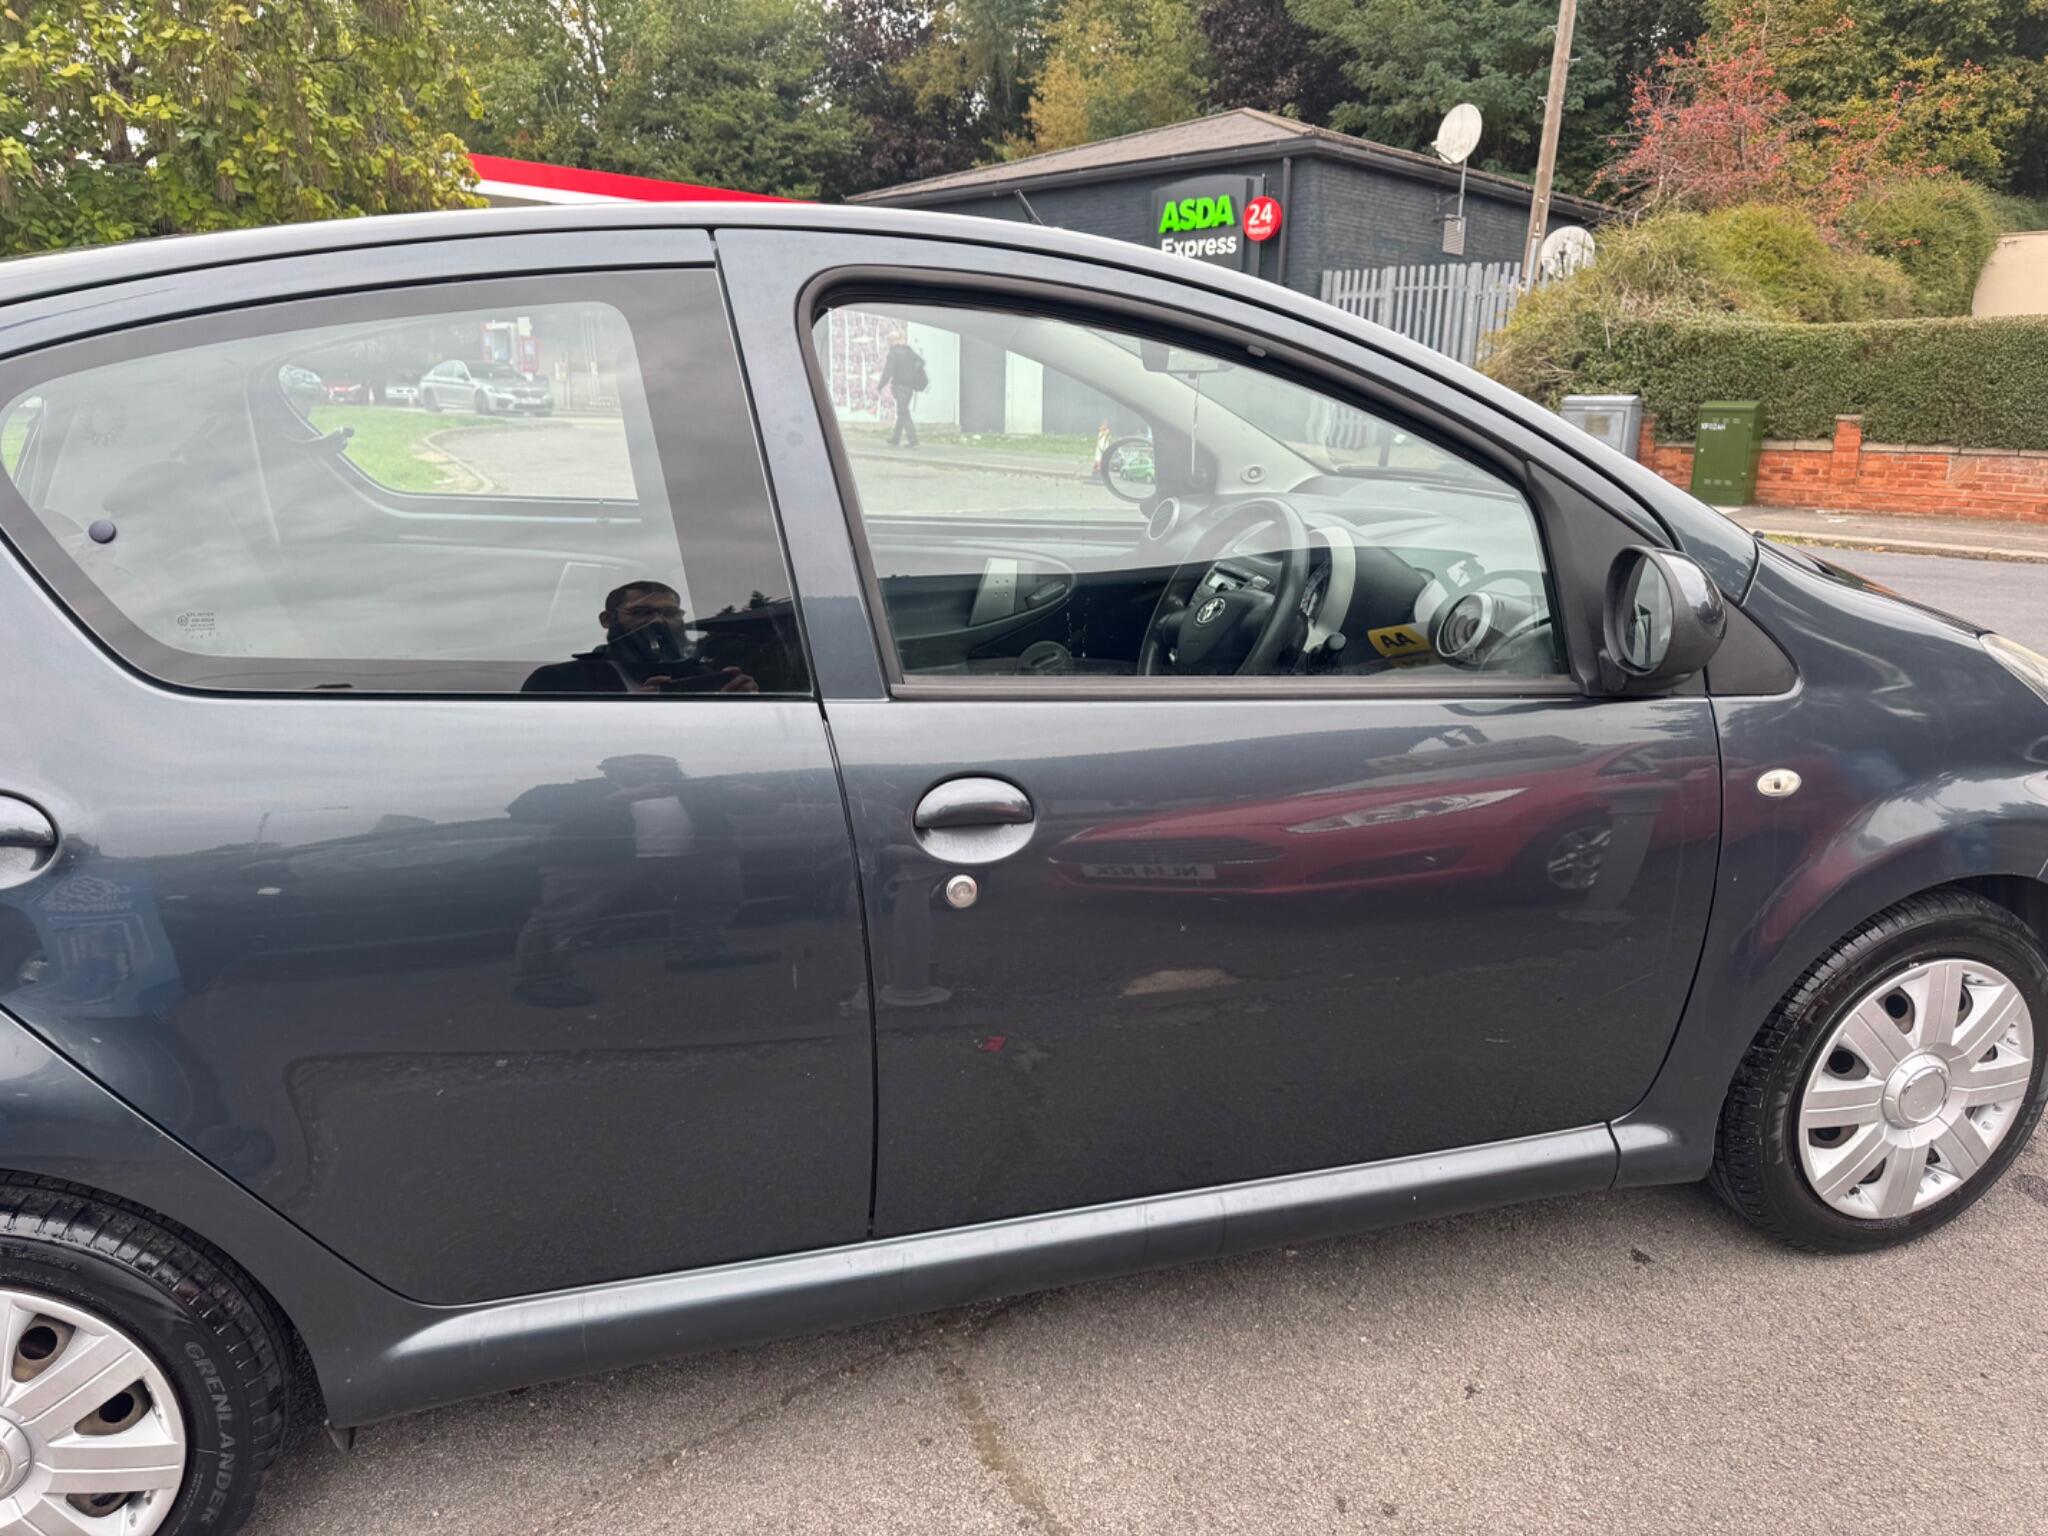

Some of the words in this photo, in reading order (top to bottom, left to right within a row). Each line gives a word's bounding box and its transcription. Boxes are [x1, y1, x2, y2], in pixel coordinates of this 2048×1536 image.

[1158, 194, 1235, 234] ASDA
[1248, 203, 1273, 225] 24
[1161, 236, 1237, 257] Express
[1380, 631, 1417, 648] AA
[185, 1341, 236, 1524] GRENLANDER
